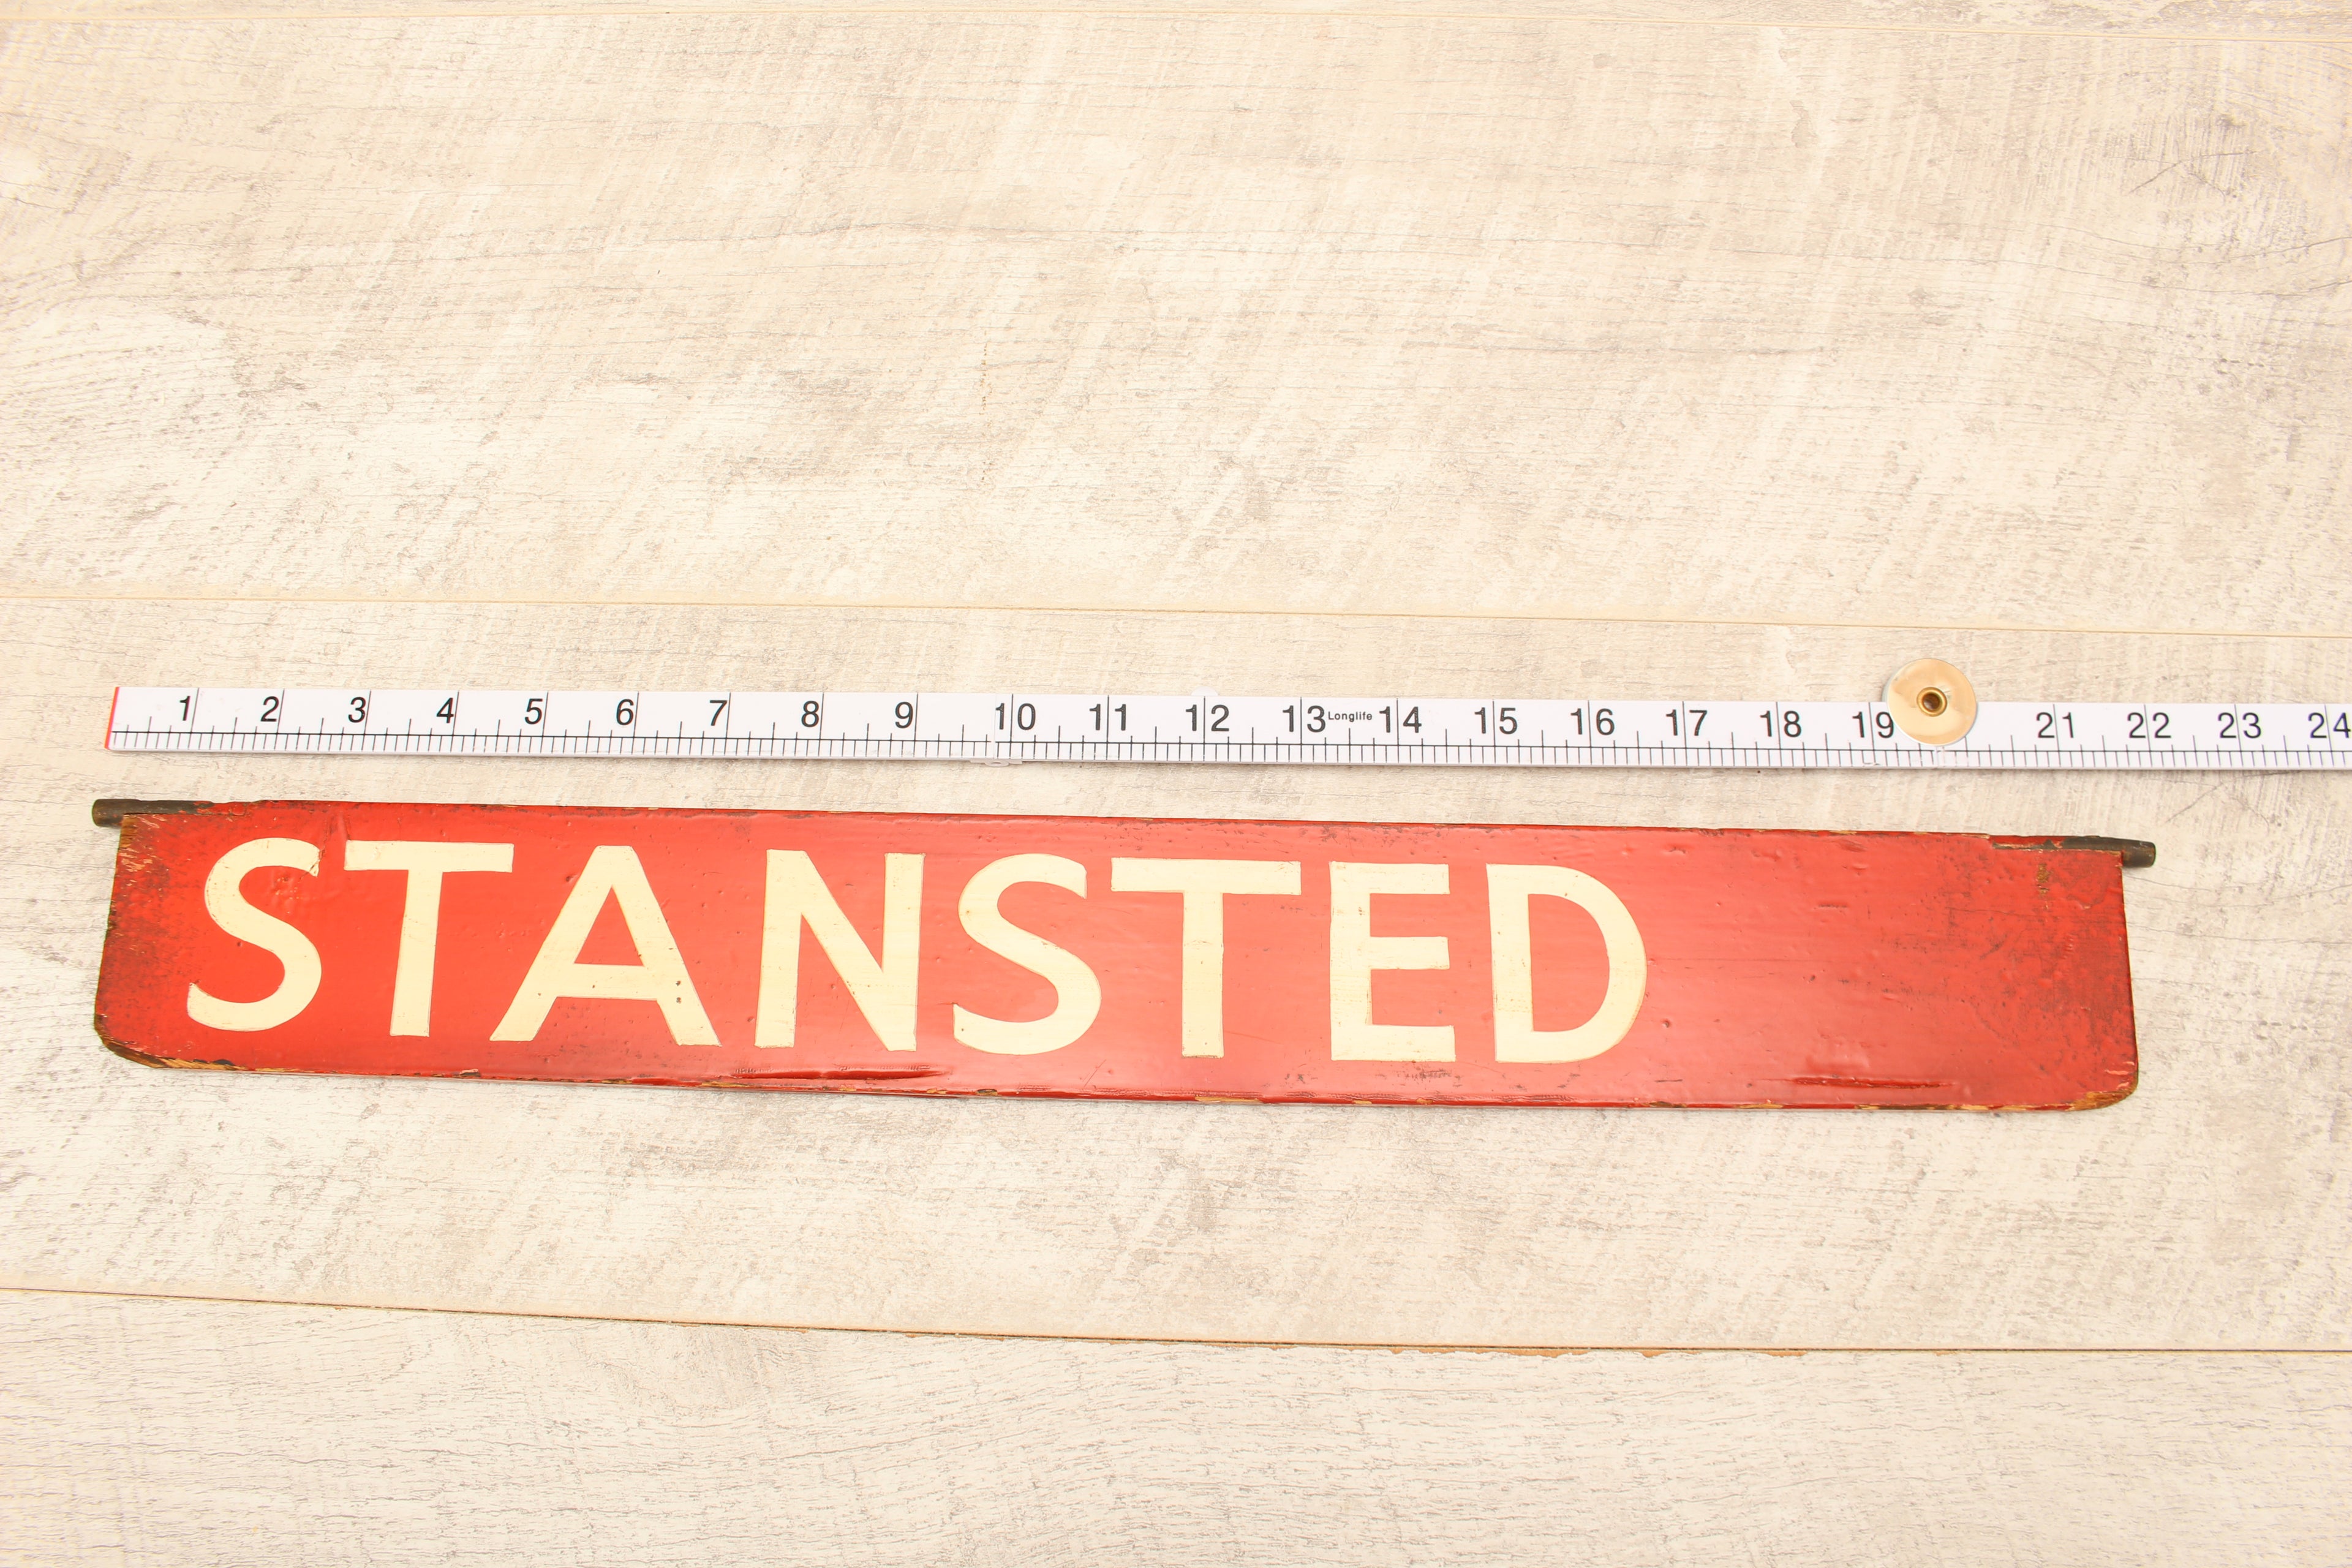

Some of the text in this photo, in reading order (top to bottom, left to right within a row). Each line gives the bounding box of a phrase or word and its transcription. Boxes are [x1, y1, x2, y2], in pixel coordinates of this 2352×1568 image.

[179, 696, 2351, 739] 1 2 3 4 5 6 7 8 9 10 11 12 13 Longlife 14 15 16 17 18 19 21 22 23 24
[187, 838, 1647, 1065] STANSTED
